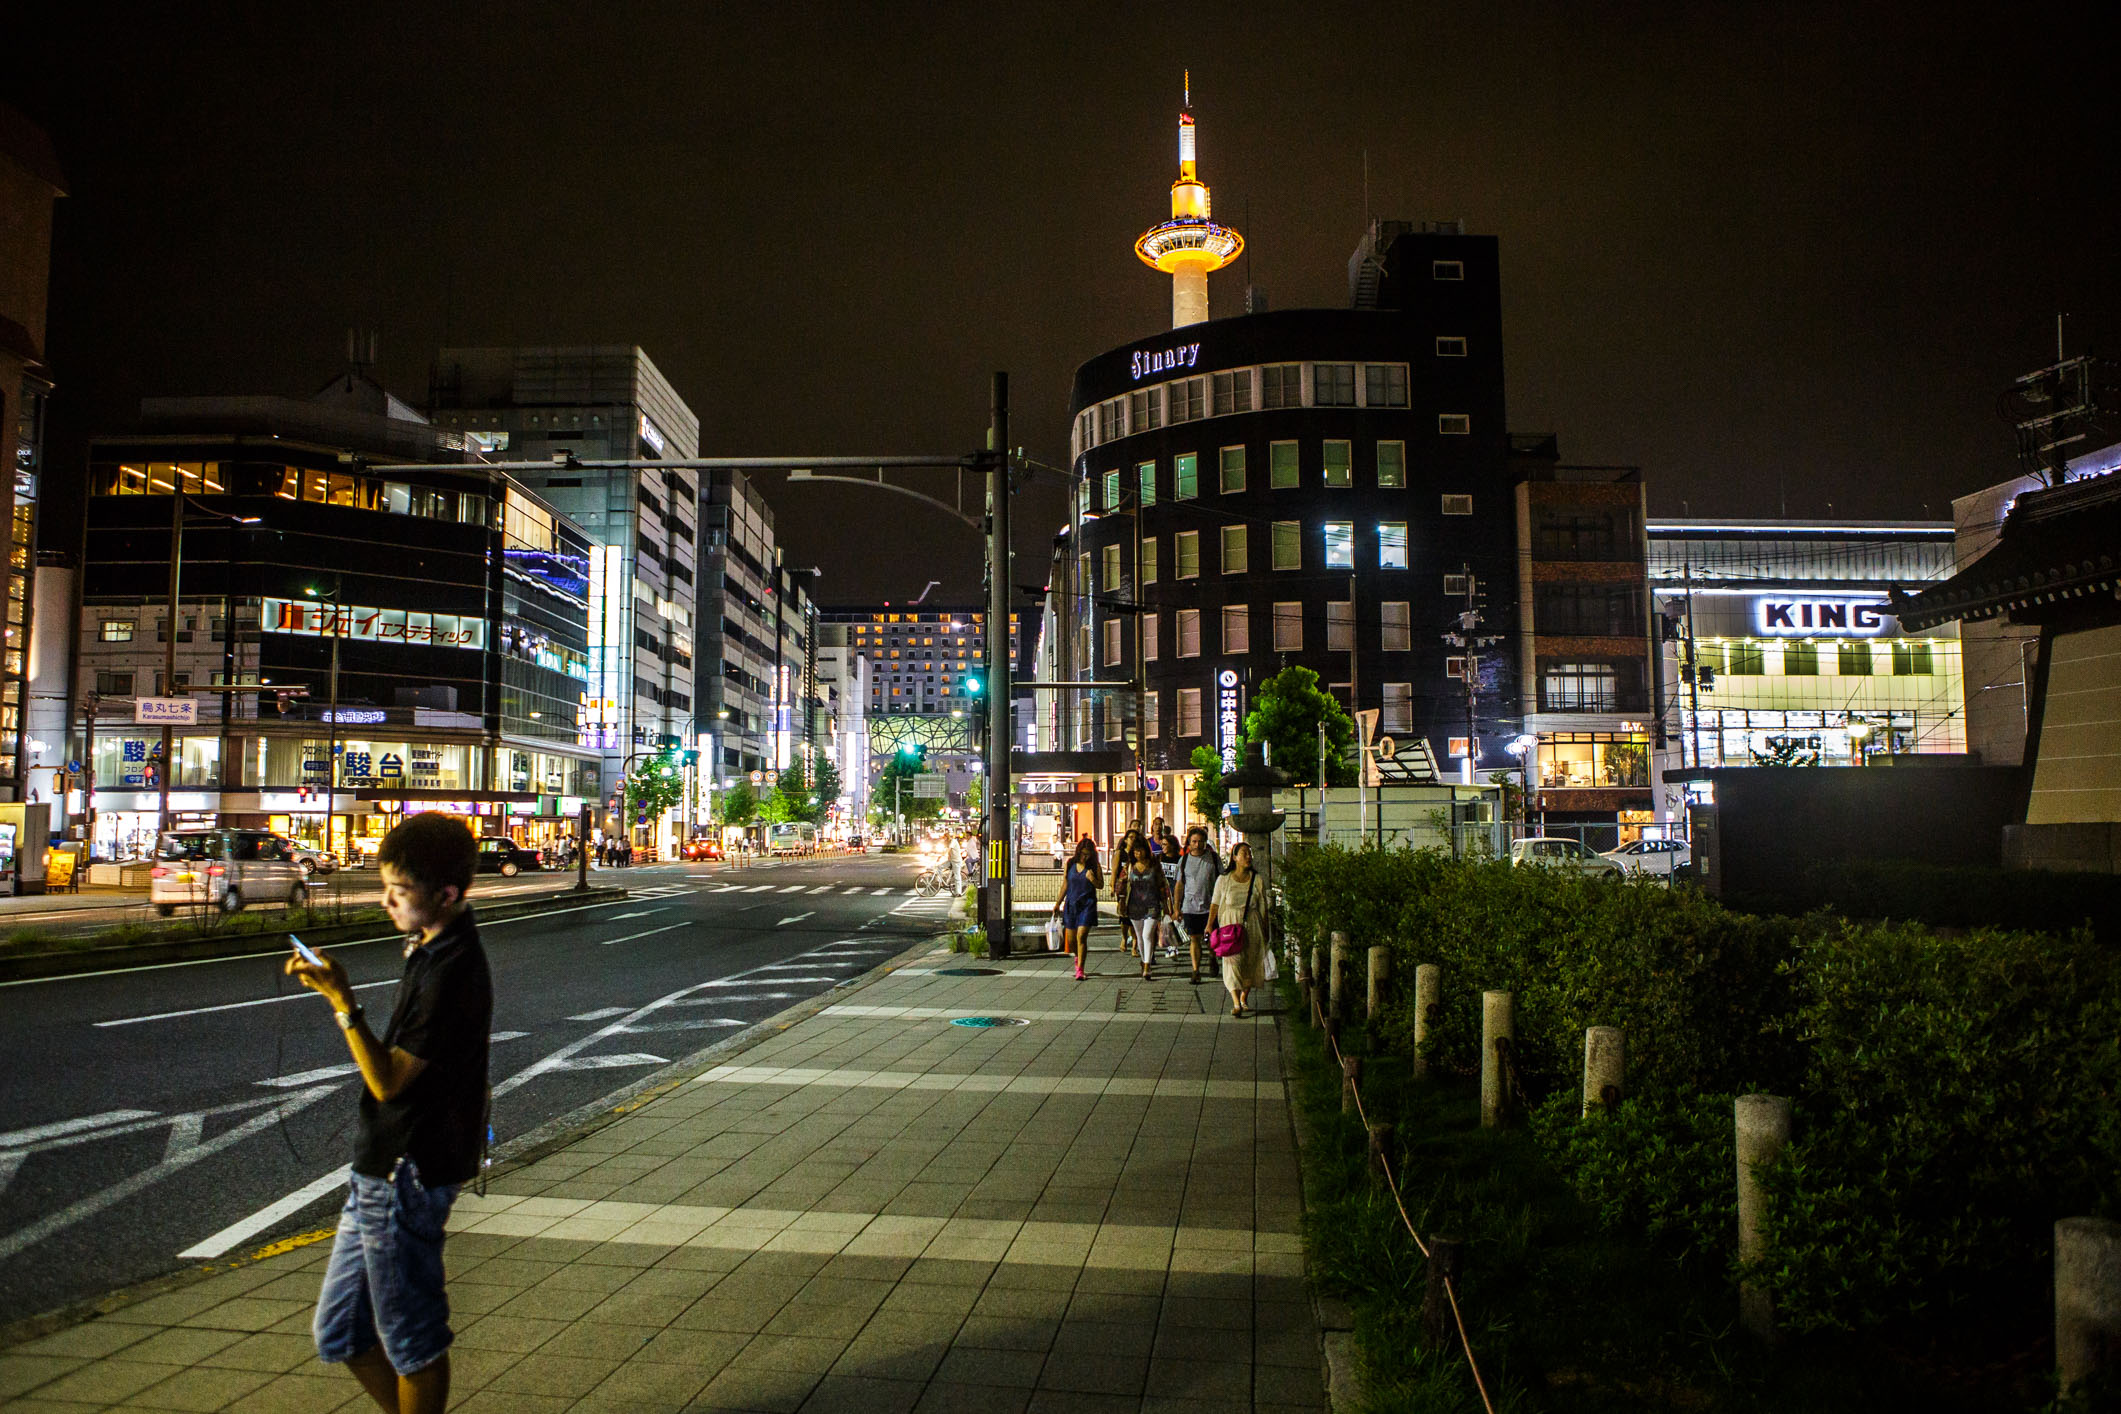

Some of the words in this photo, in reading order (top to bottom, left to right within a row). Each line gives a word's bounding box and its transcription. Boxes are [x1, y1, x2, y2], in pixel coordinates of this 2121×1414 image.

[1131, 342, 1200, 380] Sinary
[1766, 603, 1880, 628] KING
[142, 702, 193, 714] 烏丸七条
[344, 751, 404, 778] 駿台
